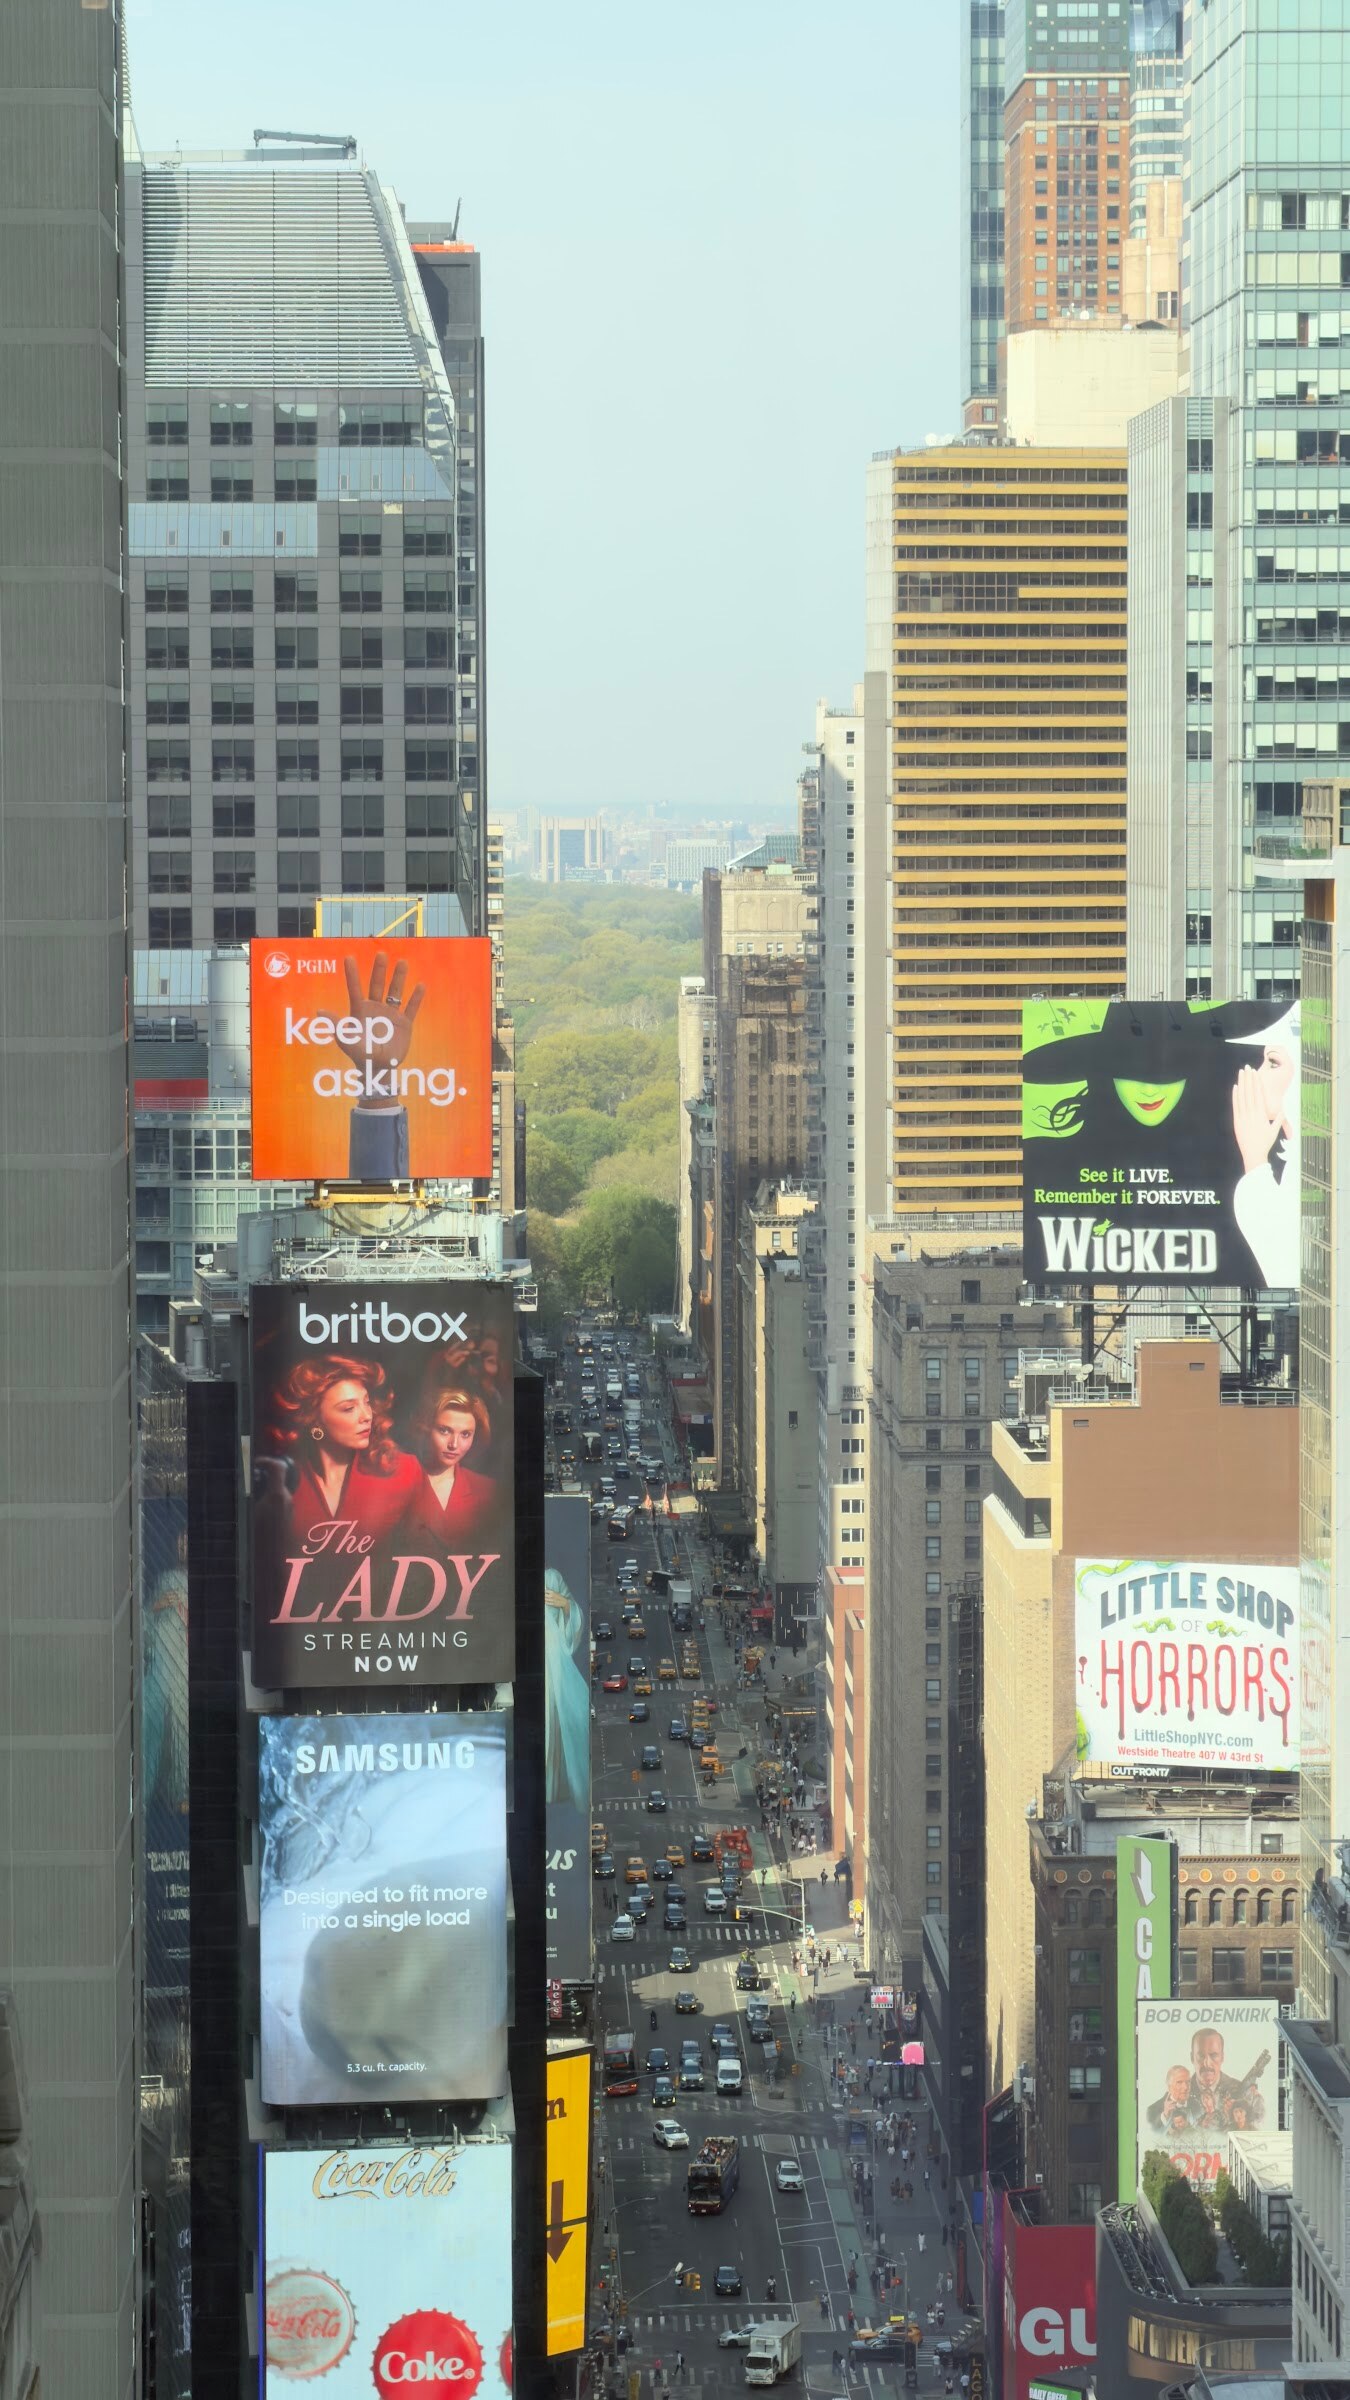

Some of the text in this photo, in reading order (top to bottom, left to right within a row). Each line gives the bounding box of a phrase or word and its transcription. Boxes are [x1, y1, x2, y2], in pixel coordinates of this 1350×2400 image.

[297, 960, 336, 974] PGIM
[285, 1008, 394, 1054] keep
[313, 1058, 467, 1106] asking.
[1080, 1168, 1174, 1183] See it LIVE.
[1034, 1189, 1221, 1205] Remember it FOREVER.
[300, 1302, 468, 1344] britbox
[302, 1520, 375, 1555] The
[270, 1554, 500, 1624] LADY
[1100, 1572, 1295, 1639] LITTLE SHOP
[1181, 1620, 1202, 1633] OF
[303, 1631, 469, 1651] STREAMING
[354, 1655, 419, 1673] NOW
[1100, 1640, 1291, 1746] HORRORS
[1134, 1728, 1253, 1748] LittleShopNYC.com
[296, 1740, 475, 1774] SAMSUNG
[1117, 1746, 1264, 1763] Westside Theatre 407 W 43rd St
[284, 1885, 488, 1910] Designed to fit more
[302, 1909, 470, 1932] into a single load
[1145, 2007, 1272, 2023] BOB ODENKIRK
[347, 2061, 428, 2073] 5.3 cu. ft. capacity.
